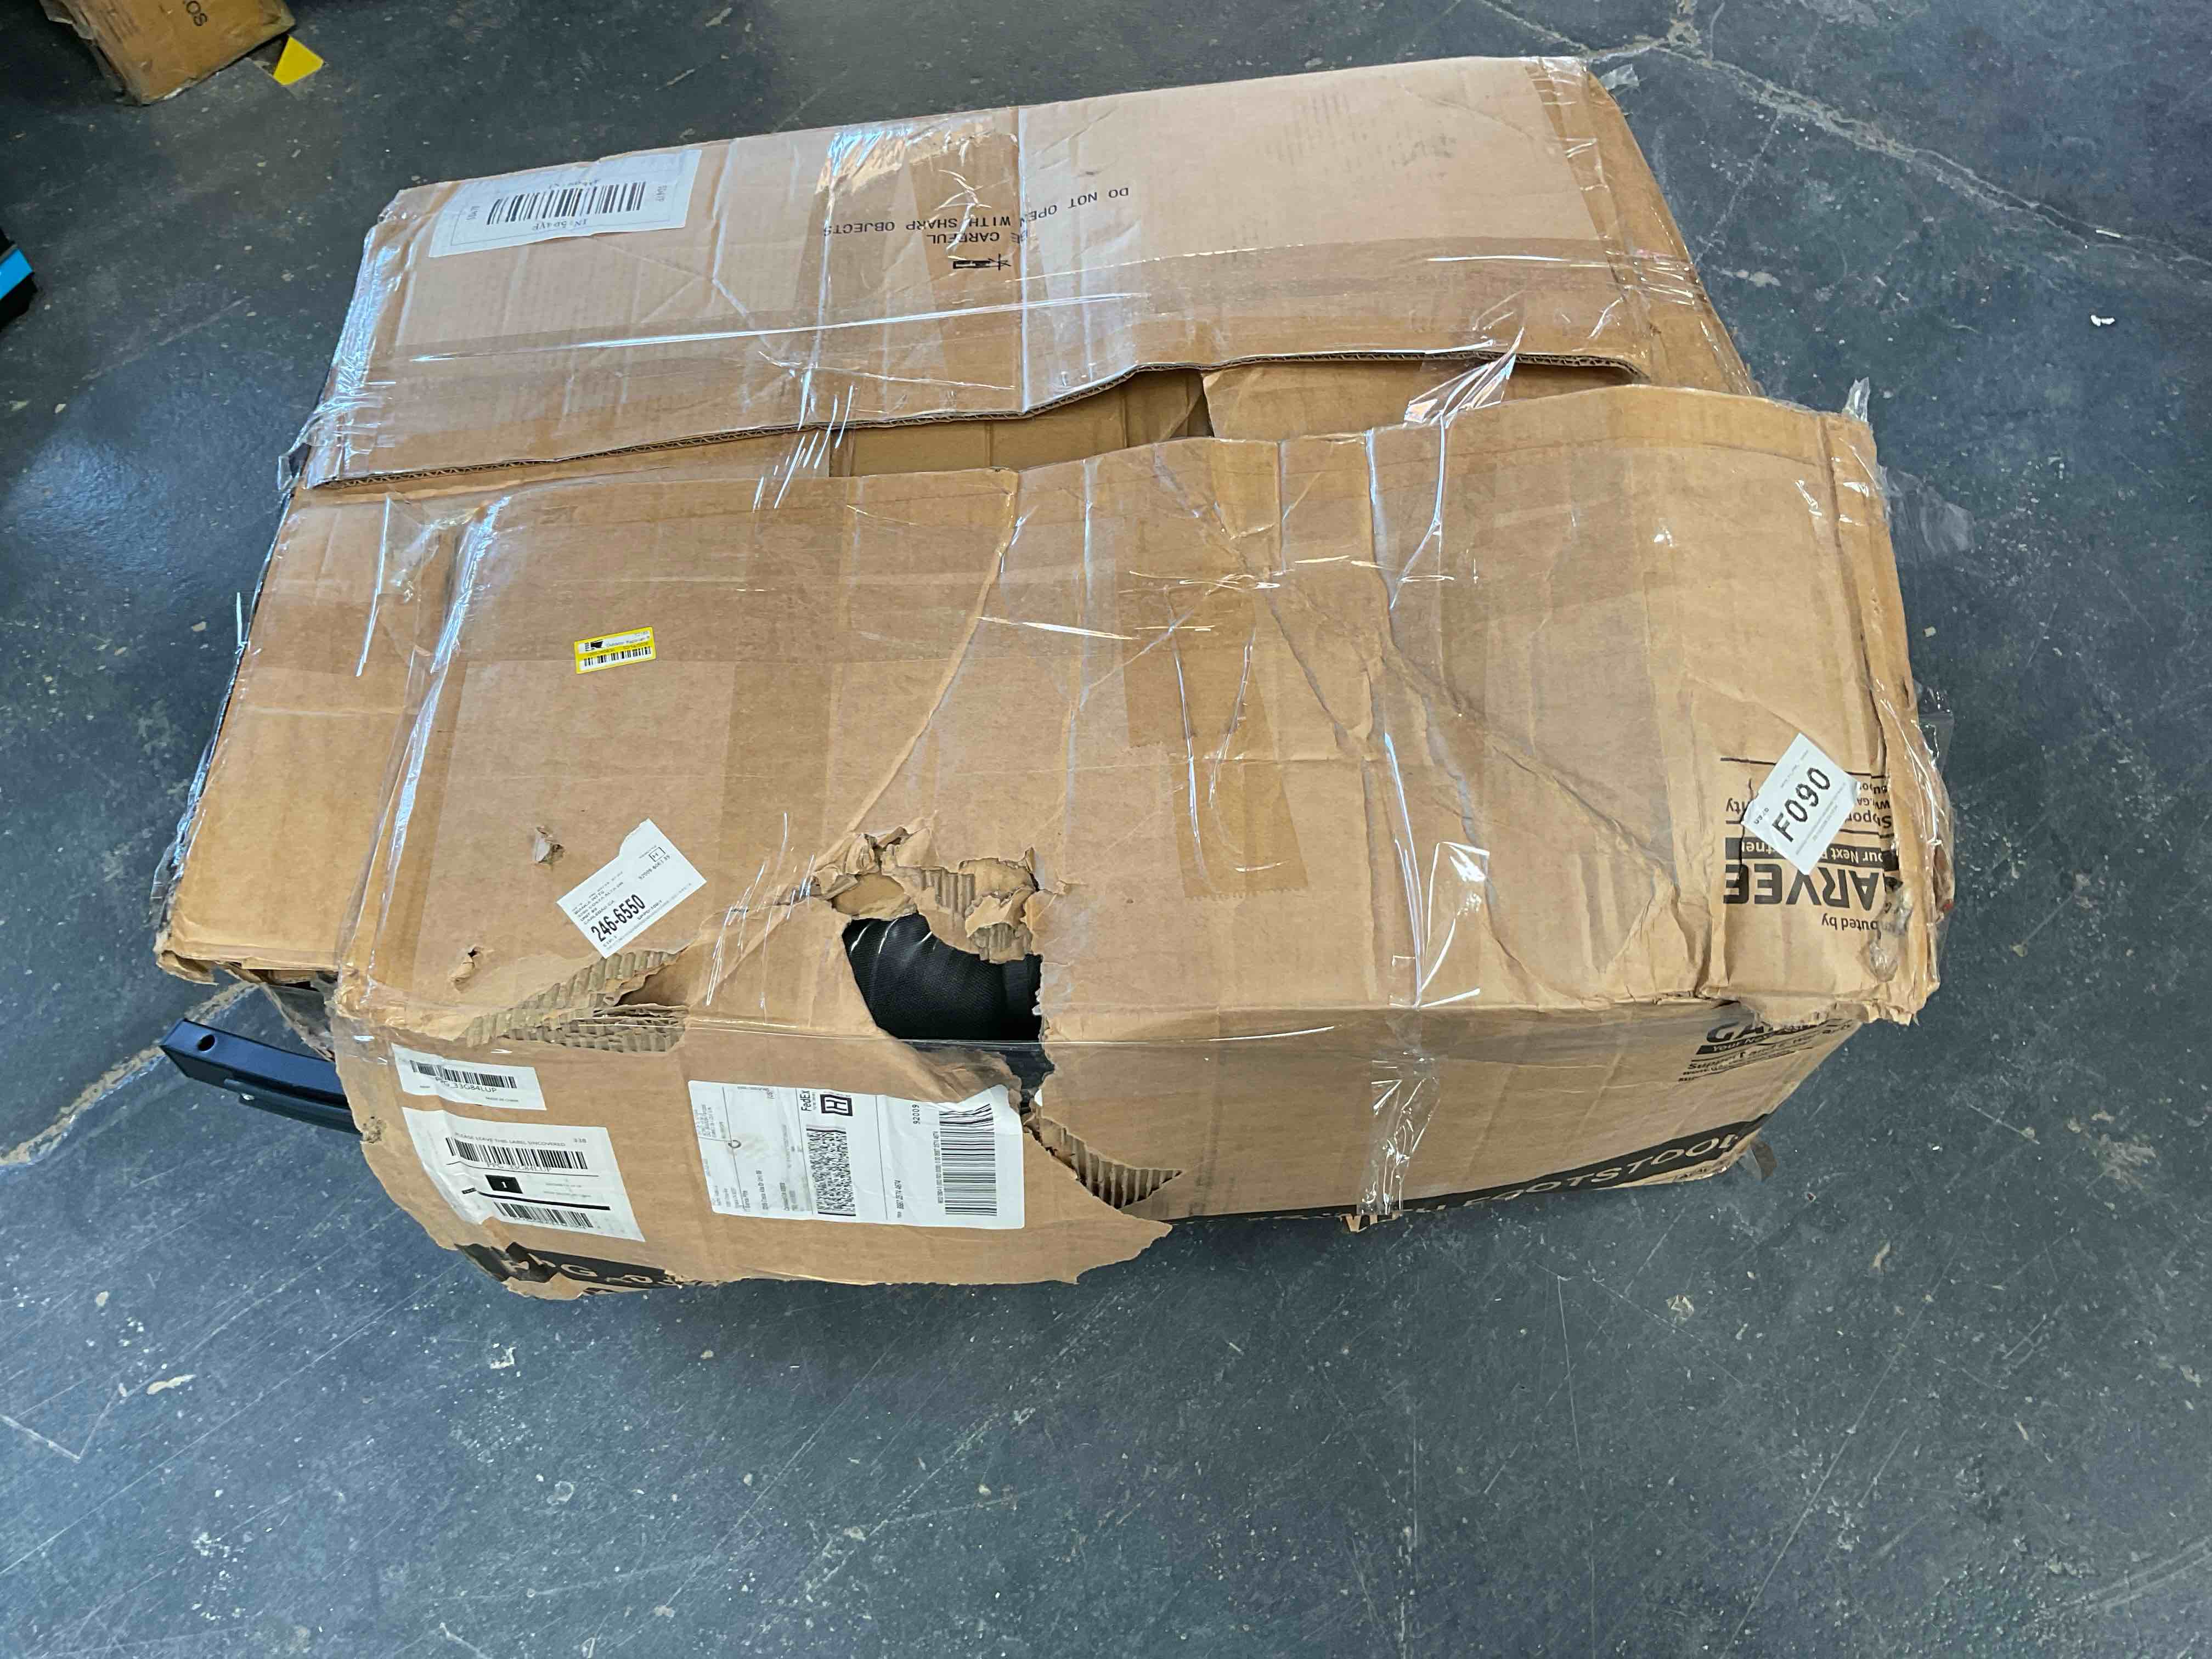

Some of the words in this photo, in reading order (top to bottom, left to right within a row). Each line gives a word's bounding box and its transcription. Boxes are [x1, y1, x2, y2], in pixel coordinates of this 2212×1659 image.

[1069, 192, 1098, 209] NOT
[1109, 188, 1130, 199] DO
[823, 219, 895, 236] OBJECTS
[905, 218, 958, 231] SHARP
[968, 216, 1011, 227] WITH
[927, 232, 1000, 244] CAREFUL
[1771, 767, 1831, 843] F090
[1829, 848, 1861, 863] Next
[1723, 864, 1883, 911] ARVEE
[590, 893, 646, 942] 246-6550
[1821, 913, 1838, 928] by
[799, 1090, 811, 1111] FedEx
[912, 1104, 920, 1124] 92009
